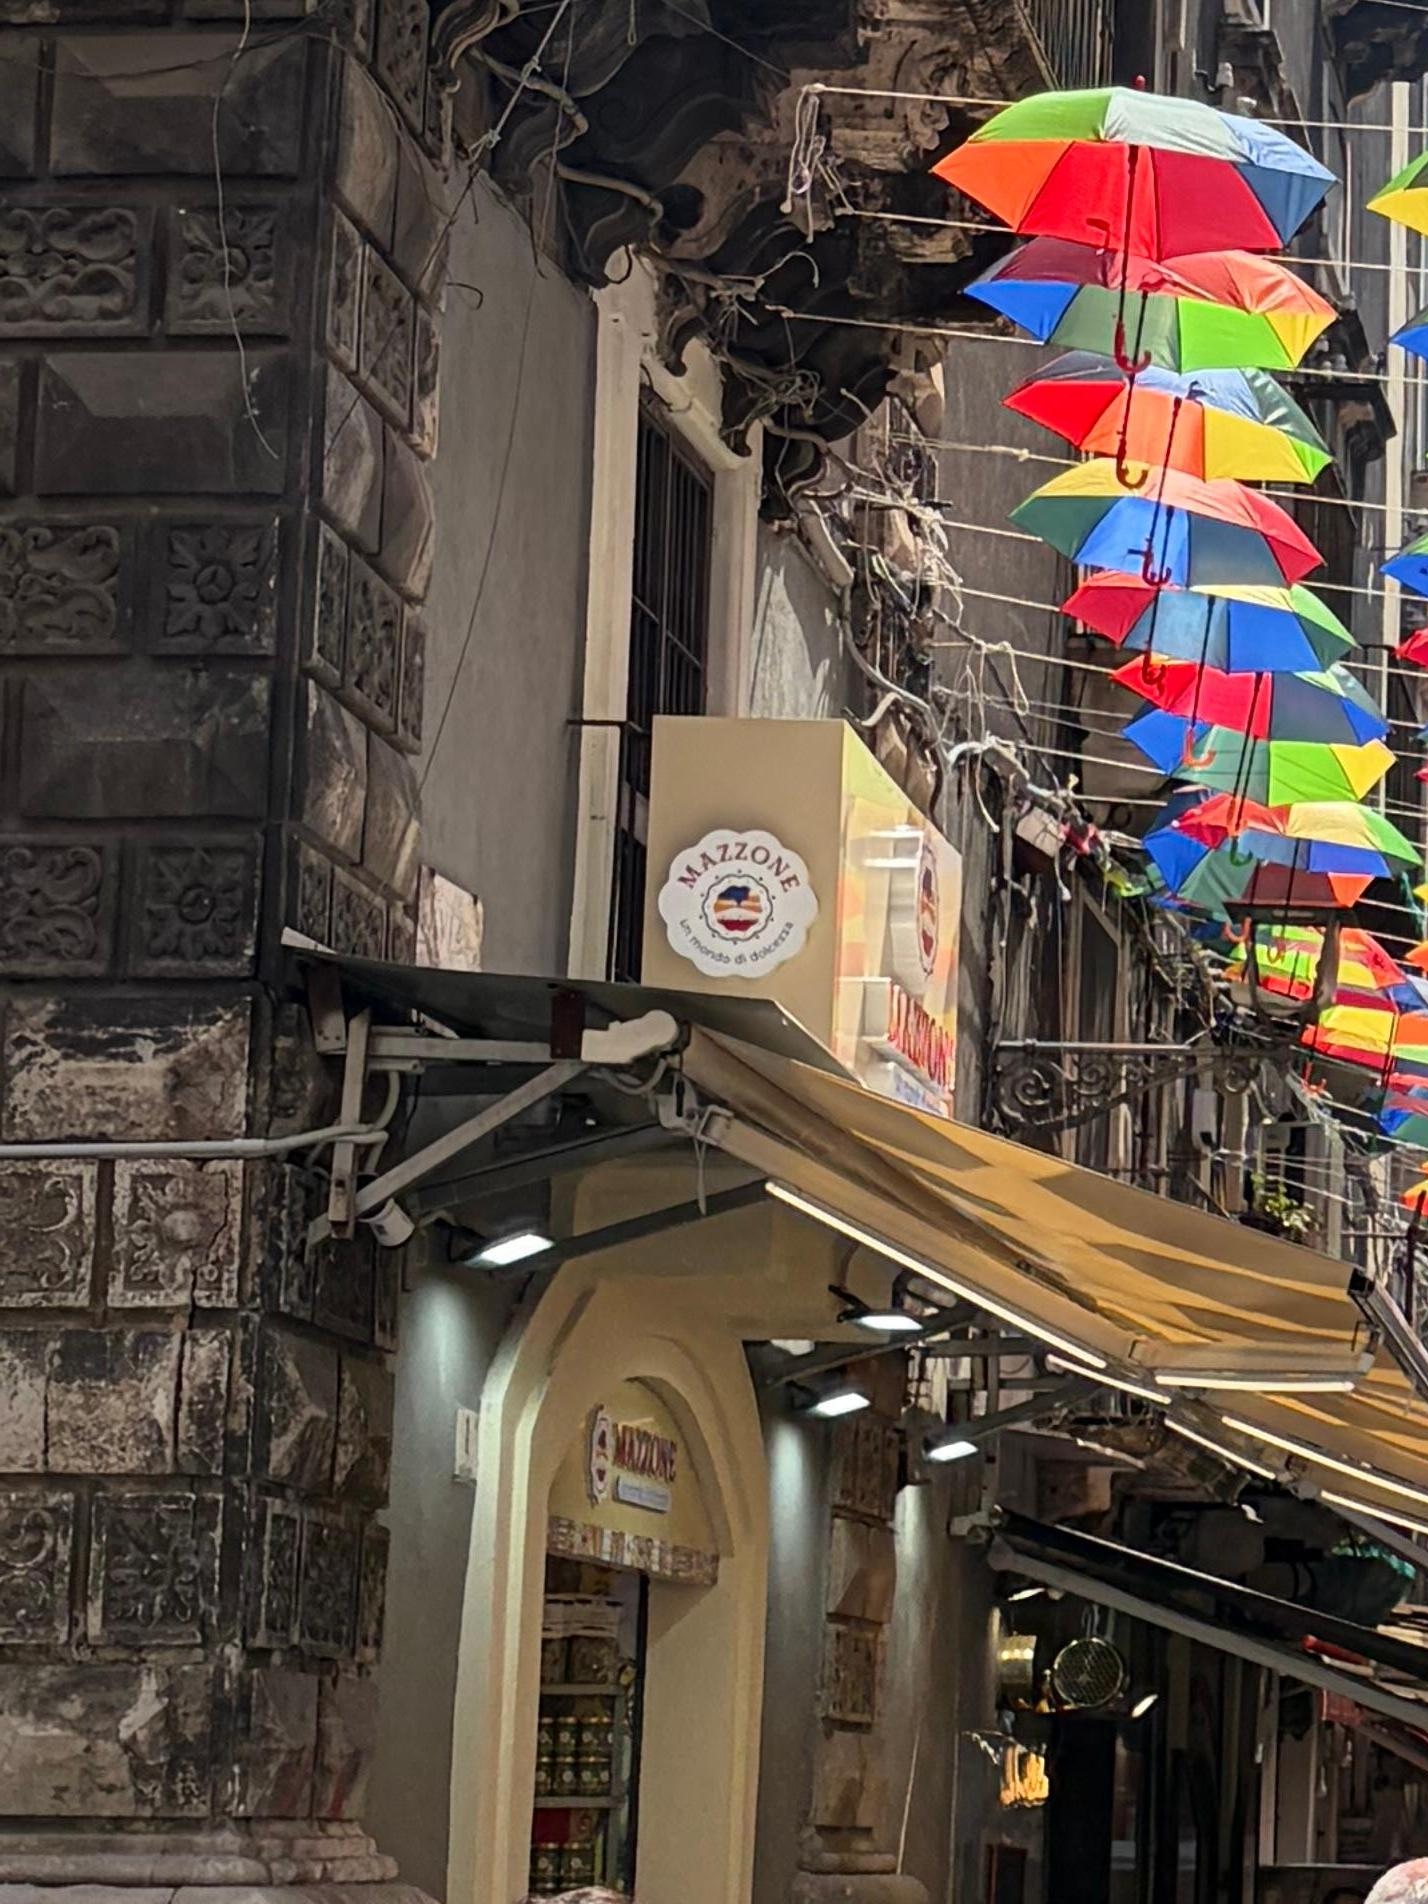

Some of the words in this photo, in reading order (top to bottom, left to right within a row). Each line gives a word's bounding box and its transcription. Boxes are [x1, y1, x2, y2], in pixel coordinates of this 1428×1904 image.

[677, 842, 801, 893] MAZZONE
[688, 937, 732, 964] mondo
[734, 951, 747, 965] di
[612, 1423, 677, 1484] MAZZONE
